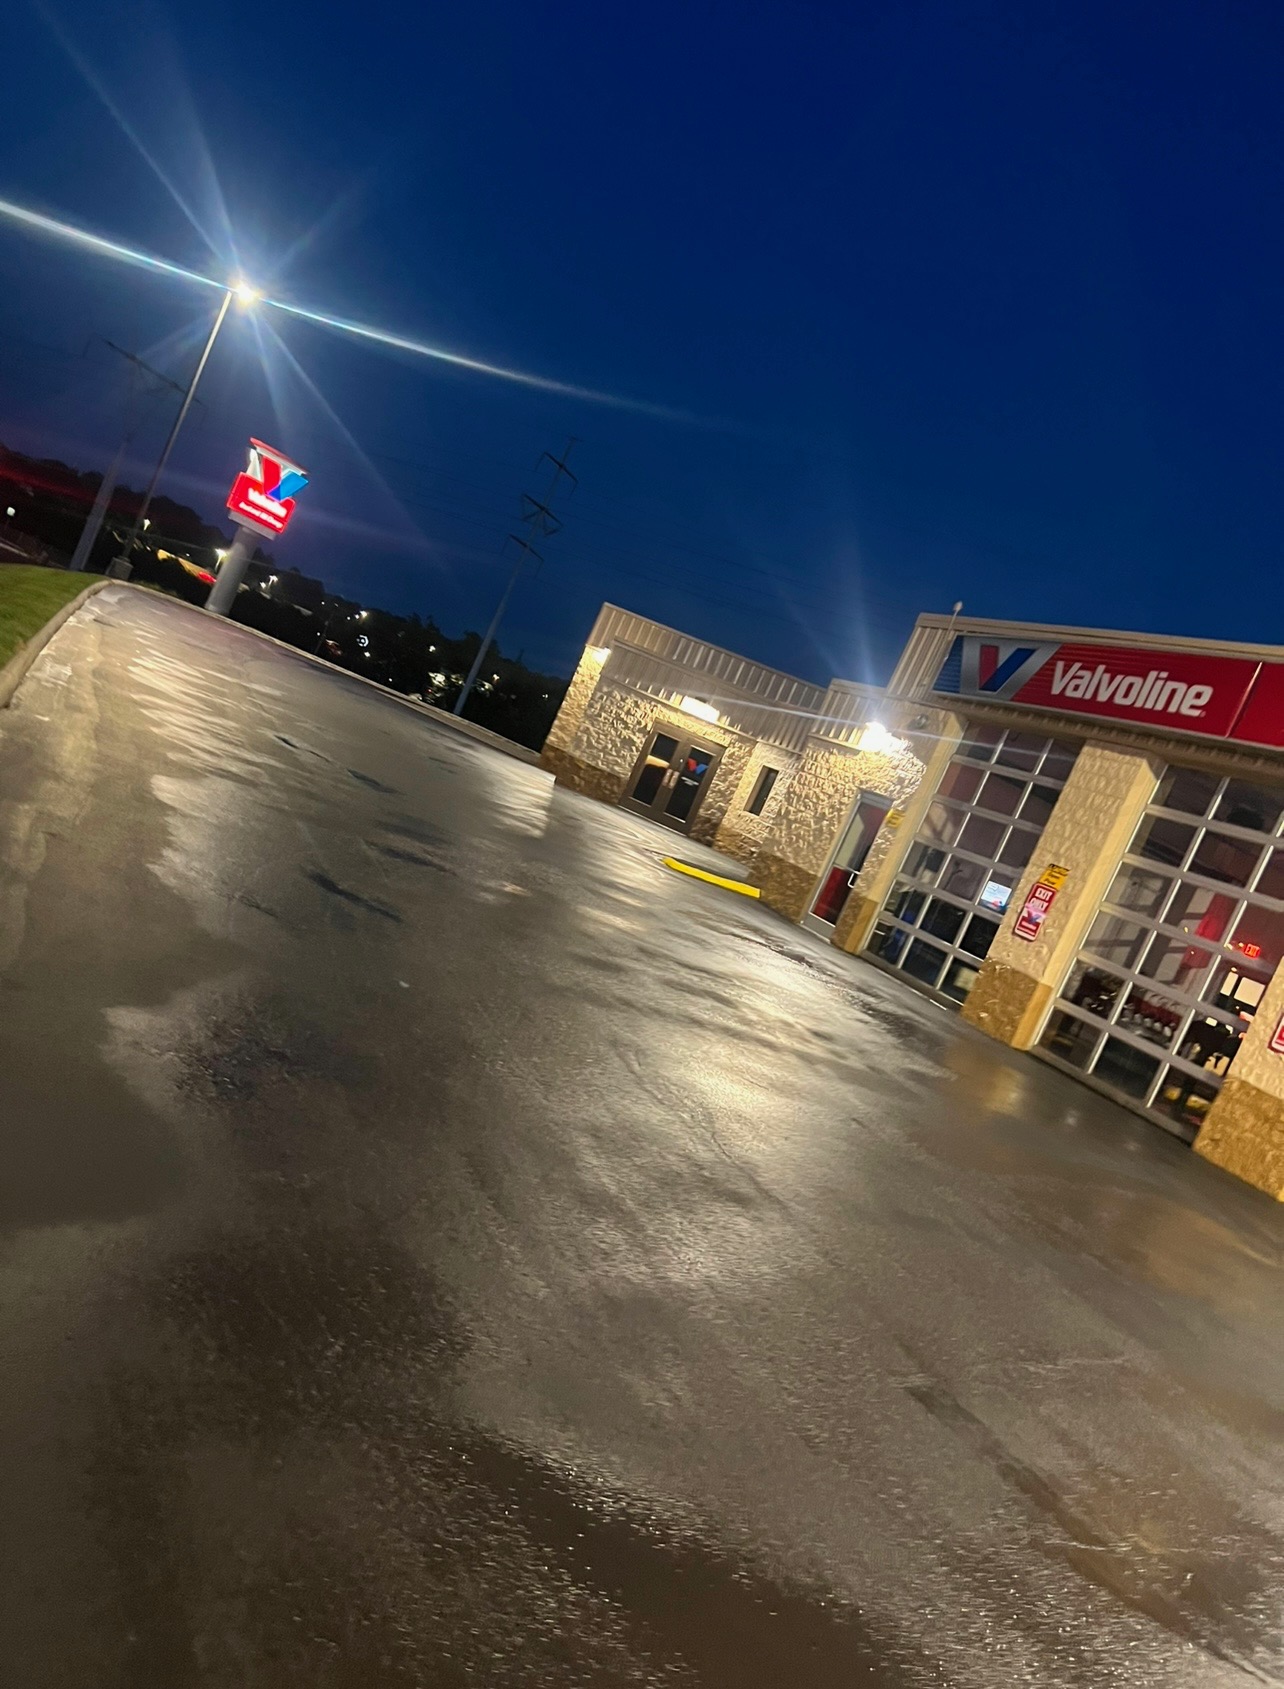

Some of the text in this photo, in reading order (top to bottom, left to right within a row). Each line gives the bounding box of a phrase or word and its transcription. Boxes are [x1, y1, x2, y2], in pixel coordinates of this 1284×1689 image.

[1050, 660, 1214, 717] Valvoline
[1034, 887, 1053, 902] EXIT
[1244, 943, 1260, 957] EXIT
